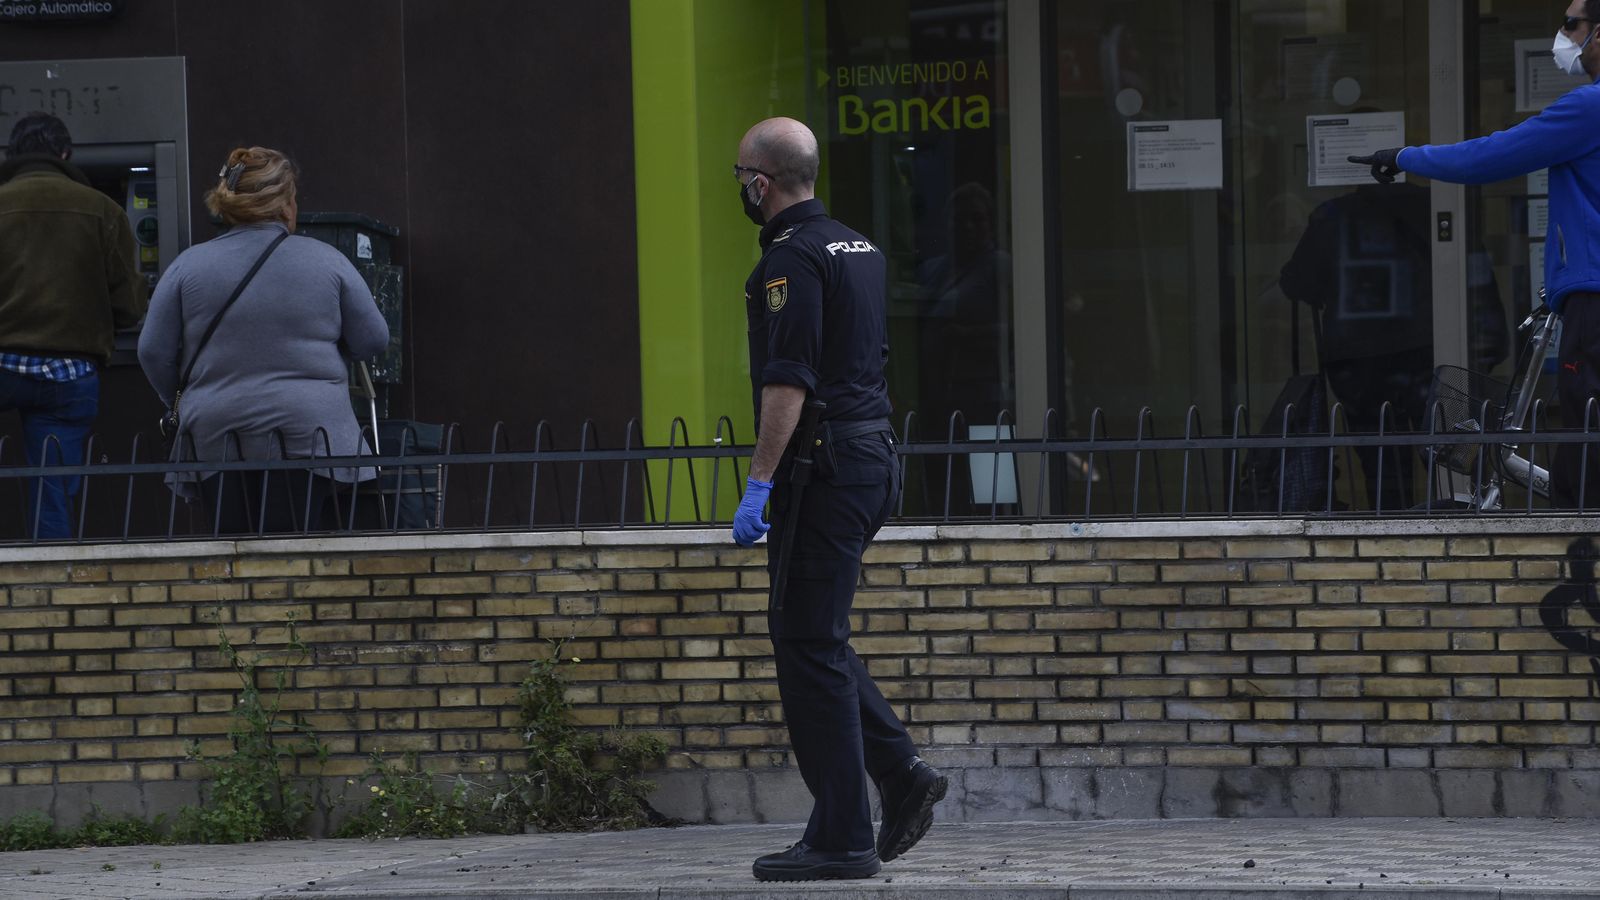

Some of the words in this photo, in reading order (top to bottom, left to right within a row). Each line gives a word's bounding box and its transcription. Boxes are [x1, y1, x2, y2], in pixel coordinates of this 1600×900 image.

[0, 3, 36, 16] ajero
[40, 0, 112, 14] Automático
[837, 60, 967, 88] BIENVENIDO
[975, 59, 989, 81] A
[838, 94, 991, 135] Bankia
